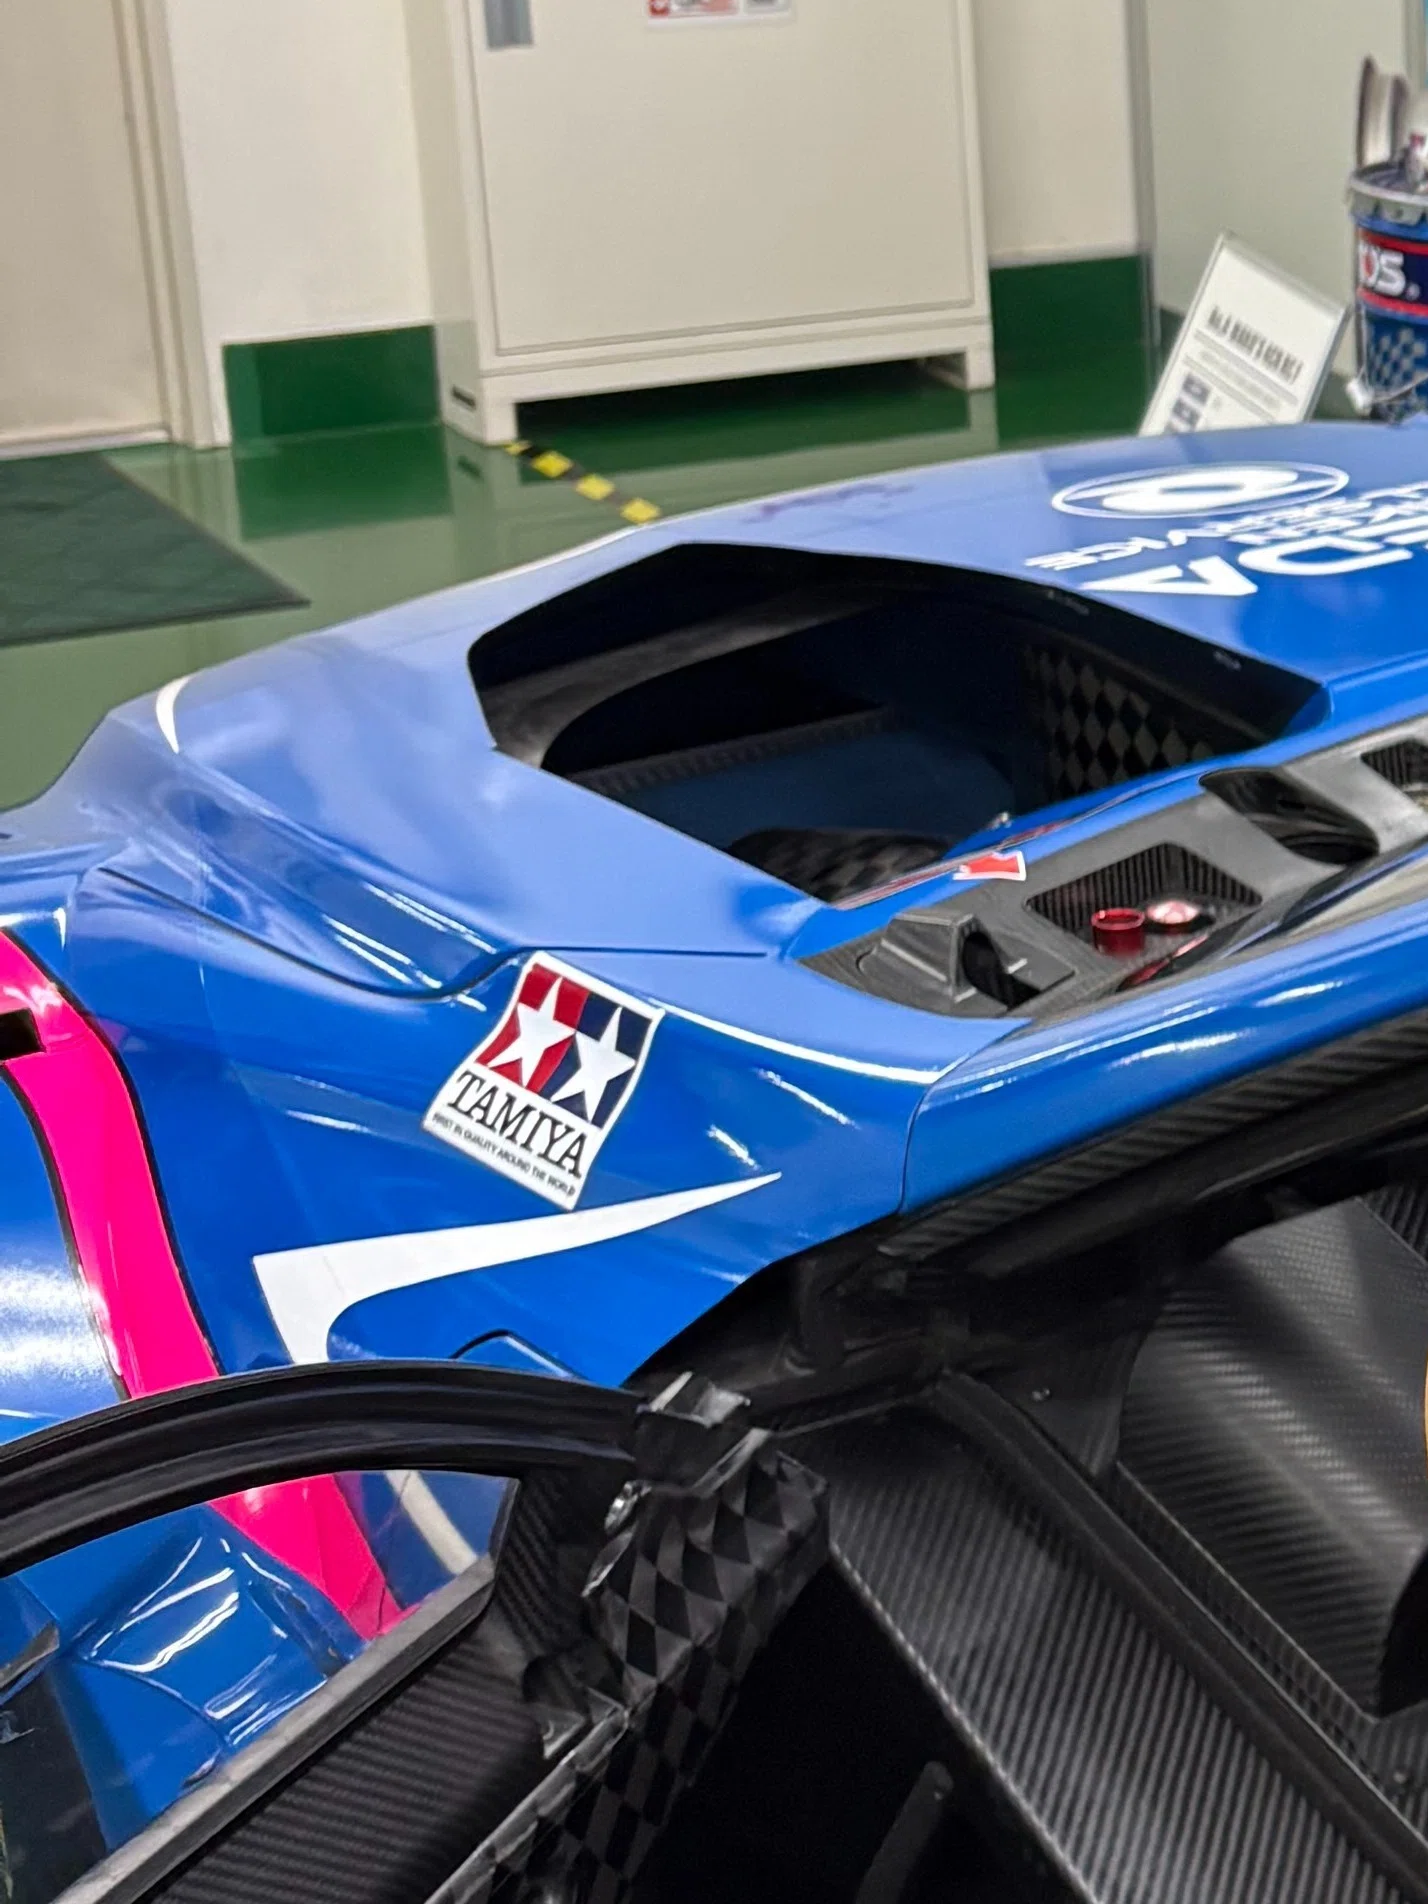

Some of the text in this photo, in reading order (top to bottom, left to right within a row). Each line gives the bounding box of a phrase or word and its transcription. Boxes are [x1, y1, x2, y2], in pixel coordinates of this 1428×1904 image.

[447, 1069, 588, 1179] TAMIYA
[463, 1128, 498, 1155] QUALITY
[496, 1147, 531, 1172] AROUND
[531, 1165, 547, 1181] THE
